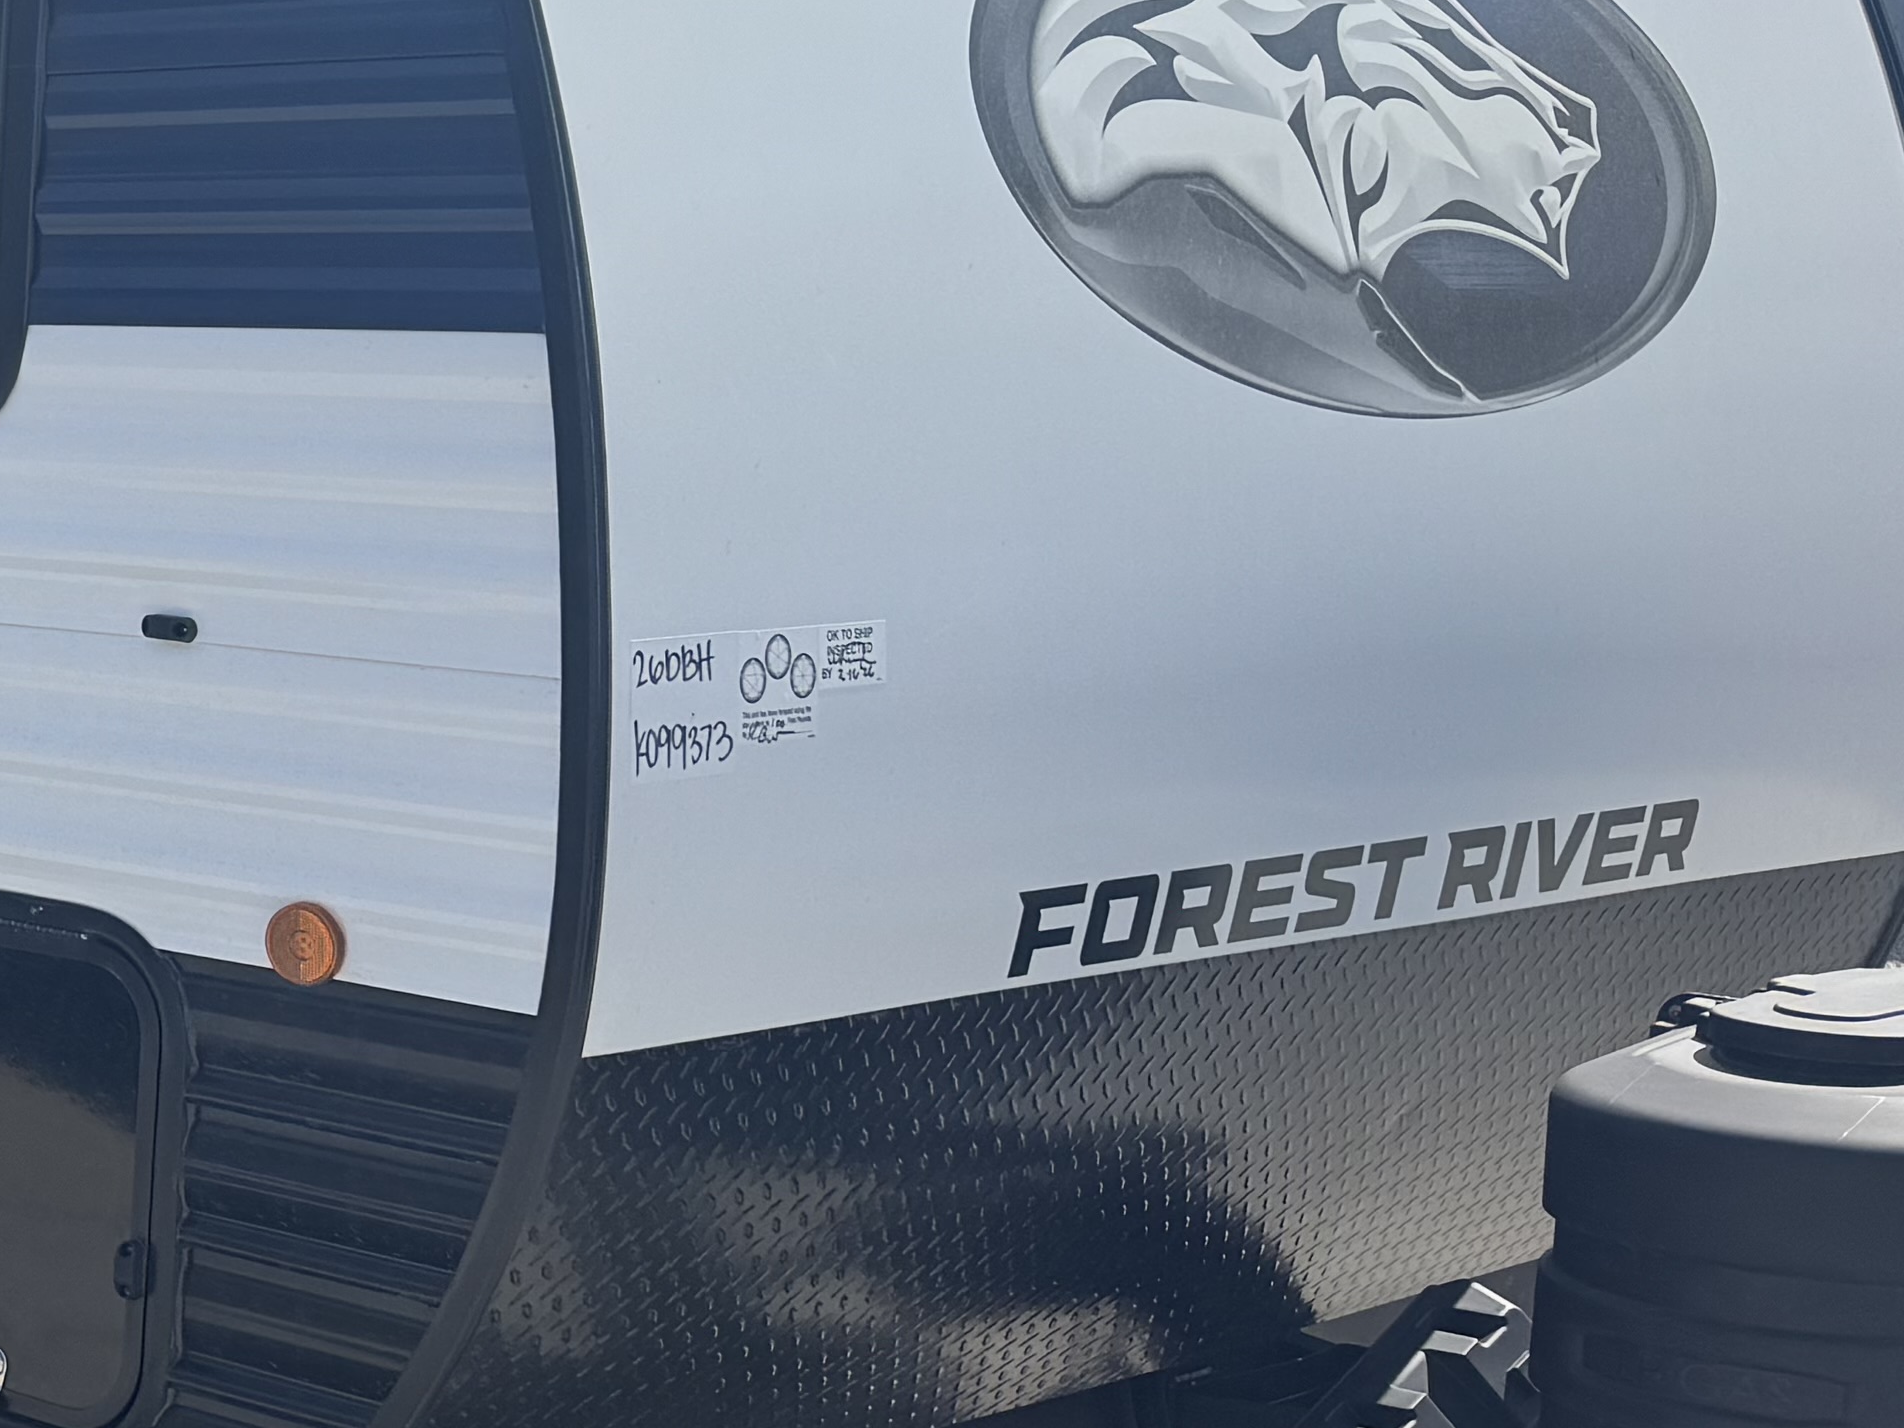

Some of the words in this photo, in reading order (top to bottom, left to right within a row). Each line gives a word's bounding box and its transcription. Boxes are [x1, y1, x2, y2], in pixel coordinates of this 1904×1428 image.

[632, 639, 716, 688] 26DBH
[1006, 835, 1428, 979] FOREST
[1437, 798, 1700, 910] RIVER
